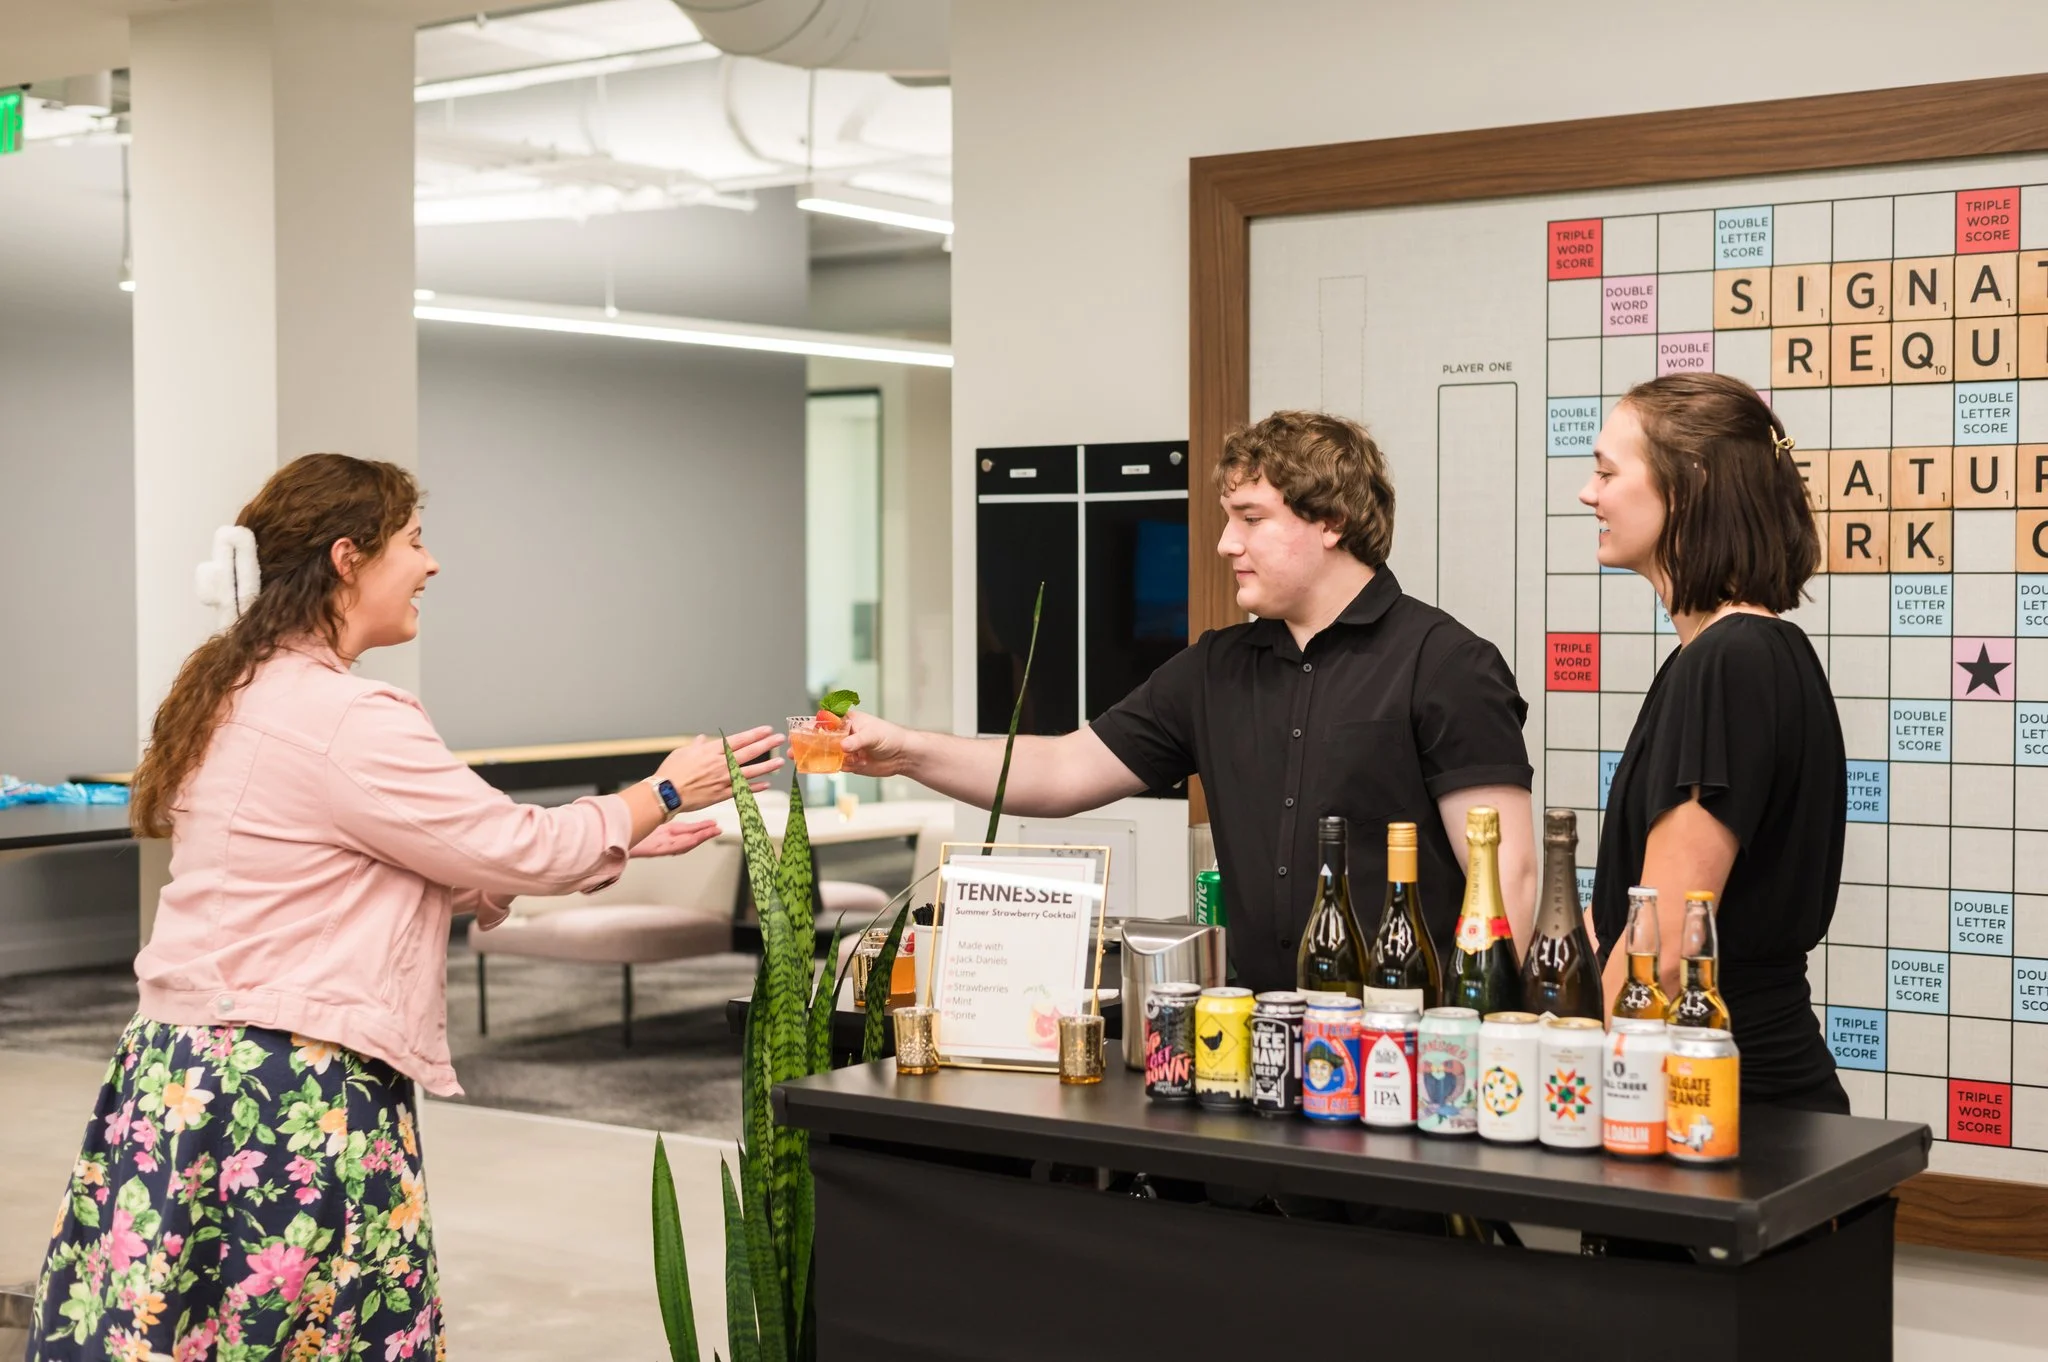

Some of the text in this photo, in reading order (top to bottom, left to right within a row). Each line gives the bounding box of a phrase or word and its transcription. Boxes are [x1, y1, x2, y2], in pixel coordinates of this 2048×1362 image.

[1966, 199, 2011, 212] TRIPLE
[1718, 217, 1769, 230] DOUBLE
[1967, 214, 2009, 227] WORD
[1556, 229, 1595, 242] TRIPLE
[1720, 232, 1766, 244] LETTER
[1965, 230, 2010, 242] SCORE
[1557, 244, 1594, 255] WORD
[1723, 247, 1764, 258] SCORE
[1556, 258, 1594, 269] SCORE
[1605, 285, 1653, 297] DOUBLE
[1611, 300, 1648, 311] WORD
[1610, 314, 1649, 325] SCORE
[1661, 343, 1709, 354] DOUBLE
[1442, 362, 1513, 374] PLAYER ONE
[1666, 357, 1704, 368] WORD
[1958, 392, 2014, 404] DOUBLE
[1550, 407, 1597, 418] DOUBLE
[1961, 408, 2011, 419] LETTER
[1552, 422, 1595, 432] LETTER
[1963, 423, 2008, 434] SCORE
[1555, 436, 1593, 446] SCORE
[1894, 585, 1948, 595] DOUBLE
[1897, 600, 1945, 610] LETTER
[1899, 615, 1943, 625] SCORE
[1554, 643, 1592, 653] TRIPLE
[1555, 657, 1591, 667] WORD
[1554, 671, 1592, 681] SCORE
[1893, 710, 1947, 722] DOUBLE
[1895, 725, 1944, 736] LETTER
[1898, 740, 1942, 751] SCORE
[957, 883, 1073, 904] TENNESSEE
[955, 907, 1077, 920] Summer Strawberry Cocktail
[1954, 902, 2009, 915] DOUBLE
[1957, 917, 2006, 929] LETTER
[1959, 932, 2004, 945] SCORE
[958, 941, 1004, 951] Made with
[956, 955, 1008, 966] Jack Daniels
[1891, 960, 1945, 973] DOUBLE
[955, 969, 976, 978] Lime
[953, 981, 1008, 993] Strawberries
[1894, 975, 1942, 988] LETTER
[952, 996, 972, 1006] Mint
[1896, 990, 1940, 1003] SCORE
[950, 1010, 977, 1021] Sprite
[1835, 1017, 1878, 1030] TRIPLE
[1253, 1031, 1285, 1049] YEE
[1832, 1031, 1880, 1045] LETTER
[1149, 1044, 1174, 1069] GET
[1834, 1047, 1877, 1060] SCORE
[1255, 1065, 1279, 1077] BEER
[1374, 1090, 1400, 1106] IPA
[1957, 1091, 2003, 1105] TRIPLE
[1959, 1106, 2001, 1119] WORD
[1957, 1121, 2002, 1134] SCORE
